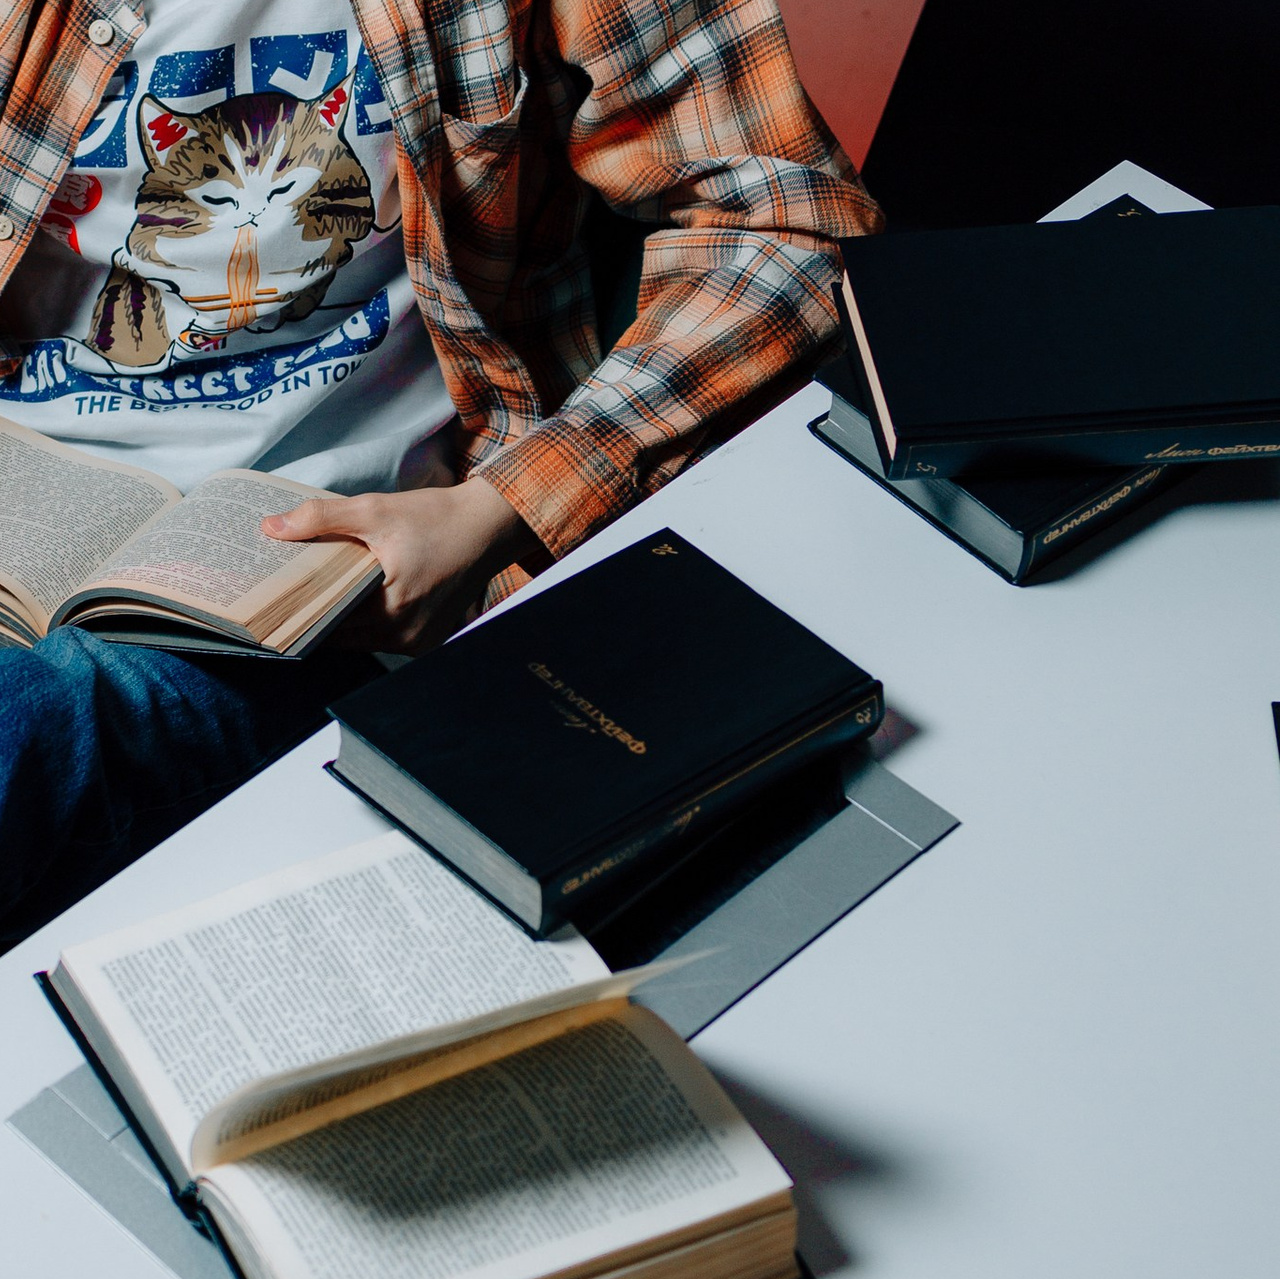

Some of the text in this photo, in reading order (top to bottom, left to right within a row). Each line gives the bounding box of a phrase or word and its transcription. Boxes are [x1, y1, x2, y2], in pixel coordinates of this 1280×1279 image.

[74, 395, 122, 416] THE
[202, 388, 274, 412] FOOD
[281, 373, 311, 394] IN
[1043, 485, 1132, 546] ФЕЙХТВАНГЕР
